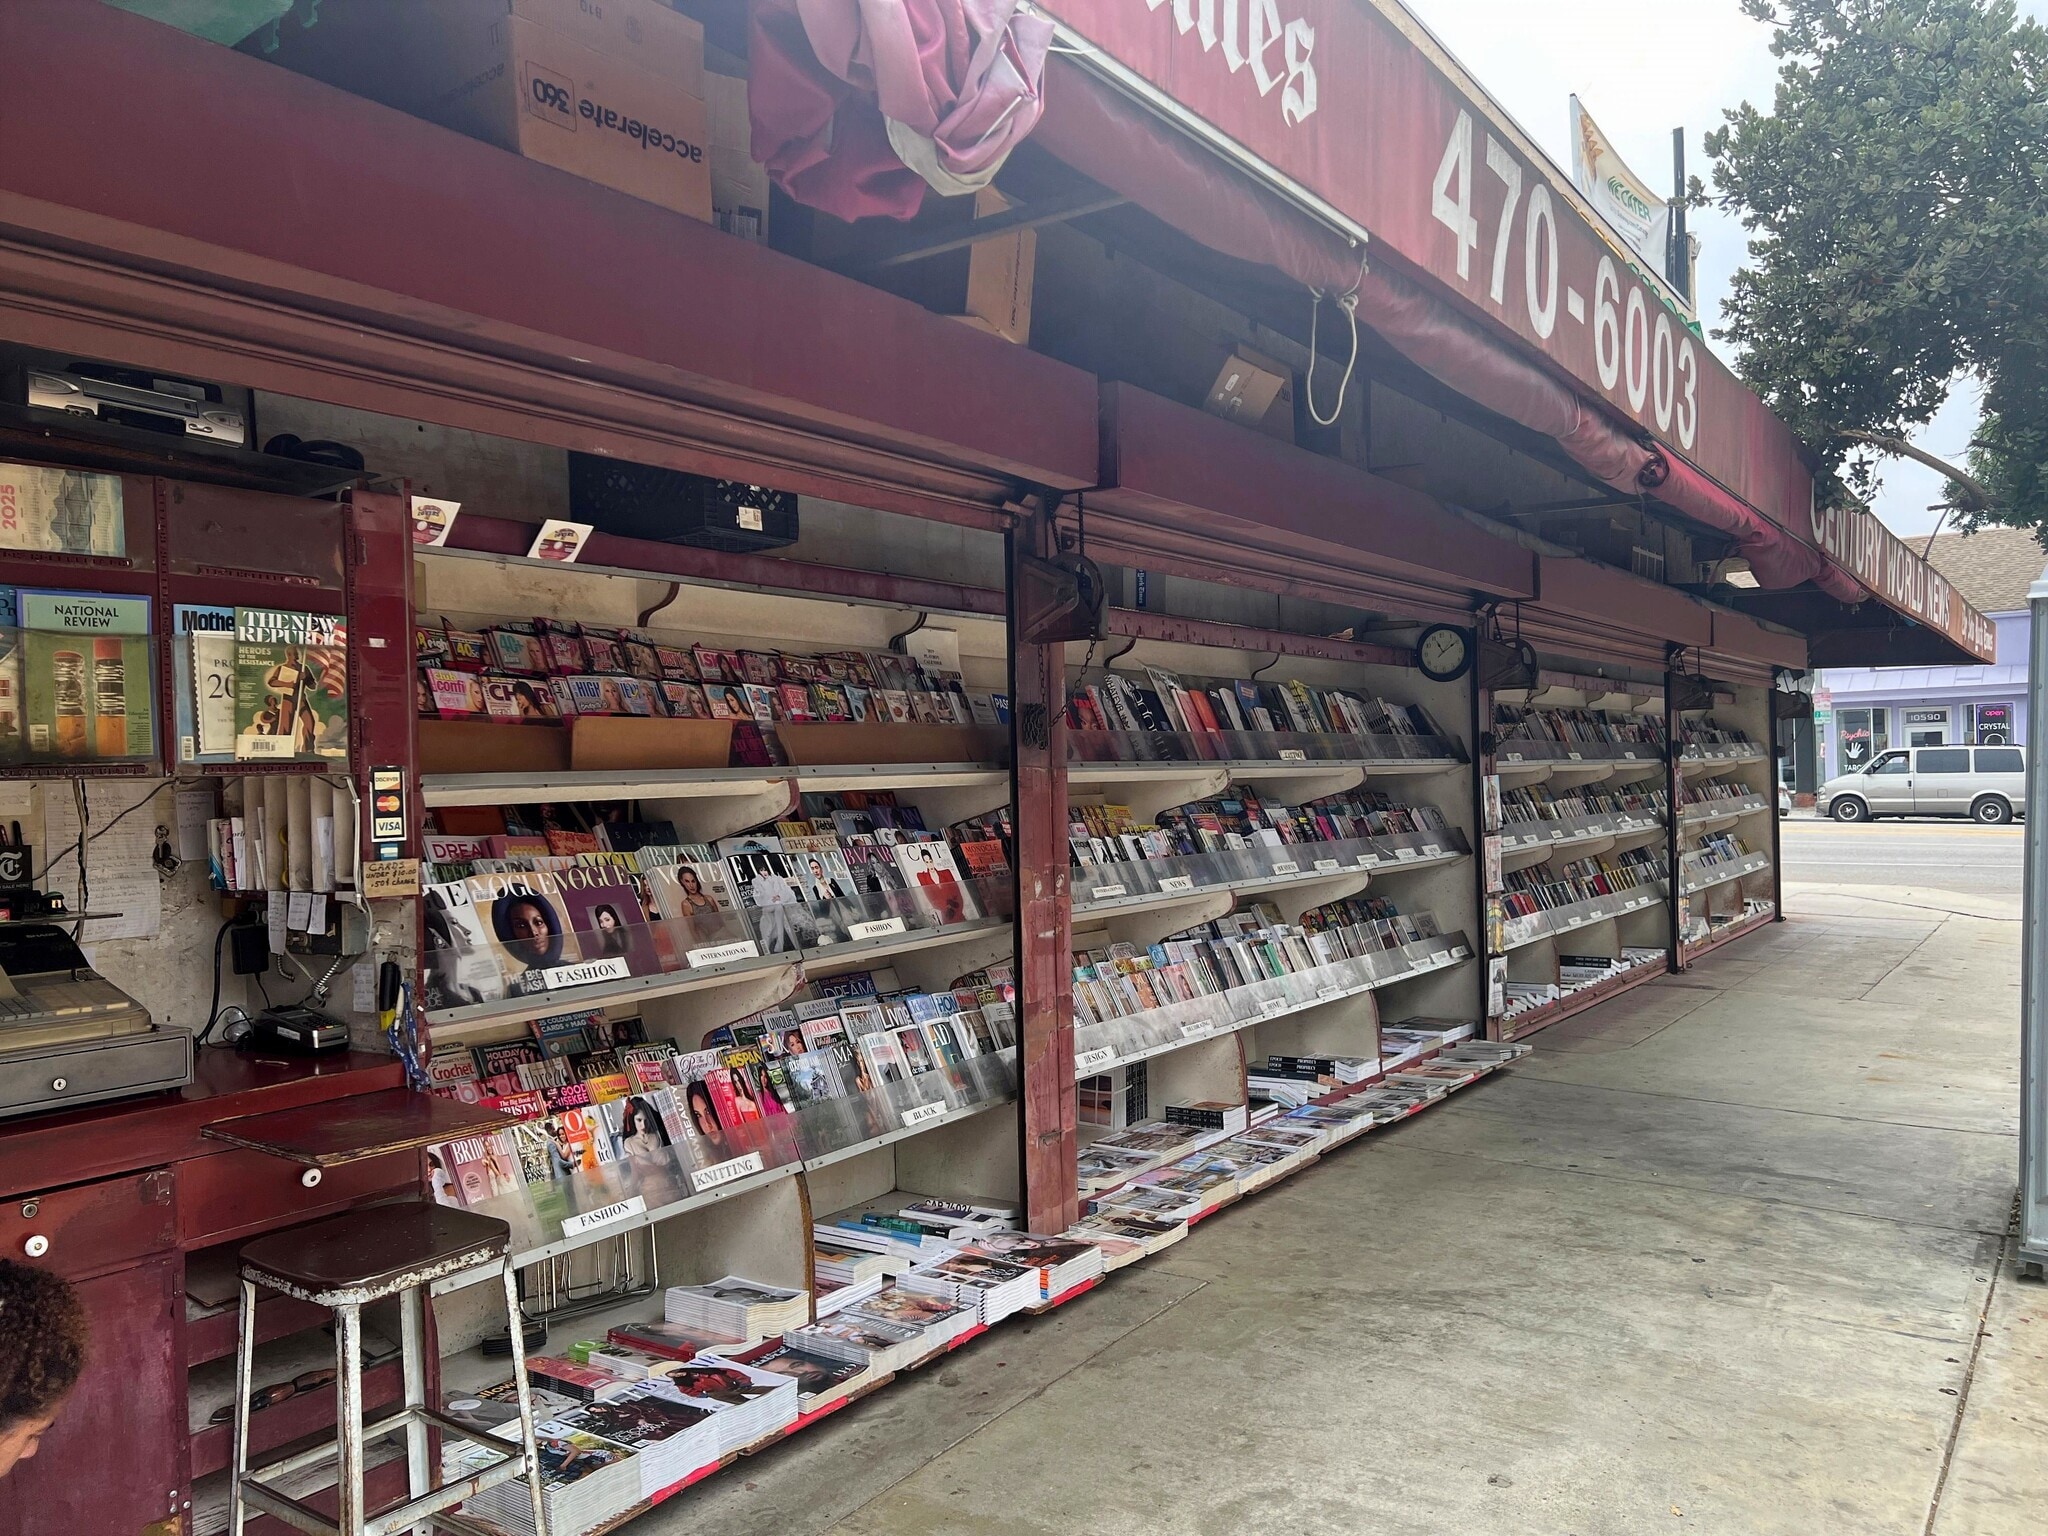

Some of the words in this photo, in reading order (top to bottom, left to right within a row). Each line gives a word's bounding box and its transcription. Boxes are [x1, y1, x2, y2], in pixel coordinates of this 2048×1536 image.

[533, 79, 569, 114] 360
[579, 99, 703, 163] accelerate
[1607, 176, 1621, 197] WE
[1621, 188, 1651, 222] CATER
[1432, 108, 1696, 449] 470-6003
[0, 484, 17, 530] 2025
[1886, 534, 1923, 613] WORLD
[1927, 569, 1950, 630] NEWS
[54, 604, 119, 618] NATIONAL
[64, 616, 111, 628] REVIEW
[242, 611, 290, 628] THE
[292, 613, 338, 634] NEW
[239, 626, 343, 647] REPUBLIC
[239, 646, 272, 656] HEROES
[239, 659, 275, 667] RESISTANCE
[1910, 713, 1940, 721] 10590
[1985, 709, 2005, 718] open
[1839, 727, 1871, 741] Psychic
[1979, 723, 2011, 732] CRYSTAL
[379, 822, 401, 831] VISA
[810, 837, 837, 849] RAKE
[965, 843, 999, 853] MONOCLE
[368, 861, 406, 872] CARDS
[730, 853, 796, 884] ELLE
[552, 865, 630, 891] VOGUE
[656, 862, 724, 887] VOUE
[470, 872, 557, 899] VOGUE
[1169, 880, 1187, 890] NEWS
[865, 922, 893, 934] FASHION
[700, 947, 749, 961] INTERNATIONAL
[504, 973, 526, 985] THE
[556, 963, 618, 983] FASHION
[541, 1023, 565, 1033] CARDS
[570, 1019, 587, 1028] MAG
[548, 1015, 572, 1025] COLOUR
[486, 1048, 521, 1061] HOLIDAY
[624, 1047, 678, 1067] QUILTING
[1084, 1052, 1109, 1066] DESIGN
[432, 1063, 475, 1081] Crochet
[561, 1083, 587, 1096] GOOD
[913, 1106, 938, 1120] BLACK
[695, 1159, 754, 1187] KNITTING
[580, 1202, 630, 1227] FASHION
